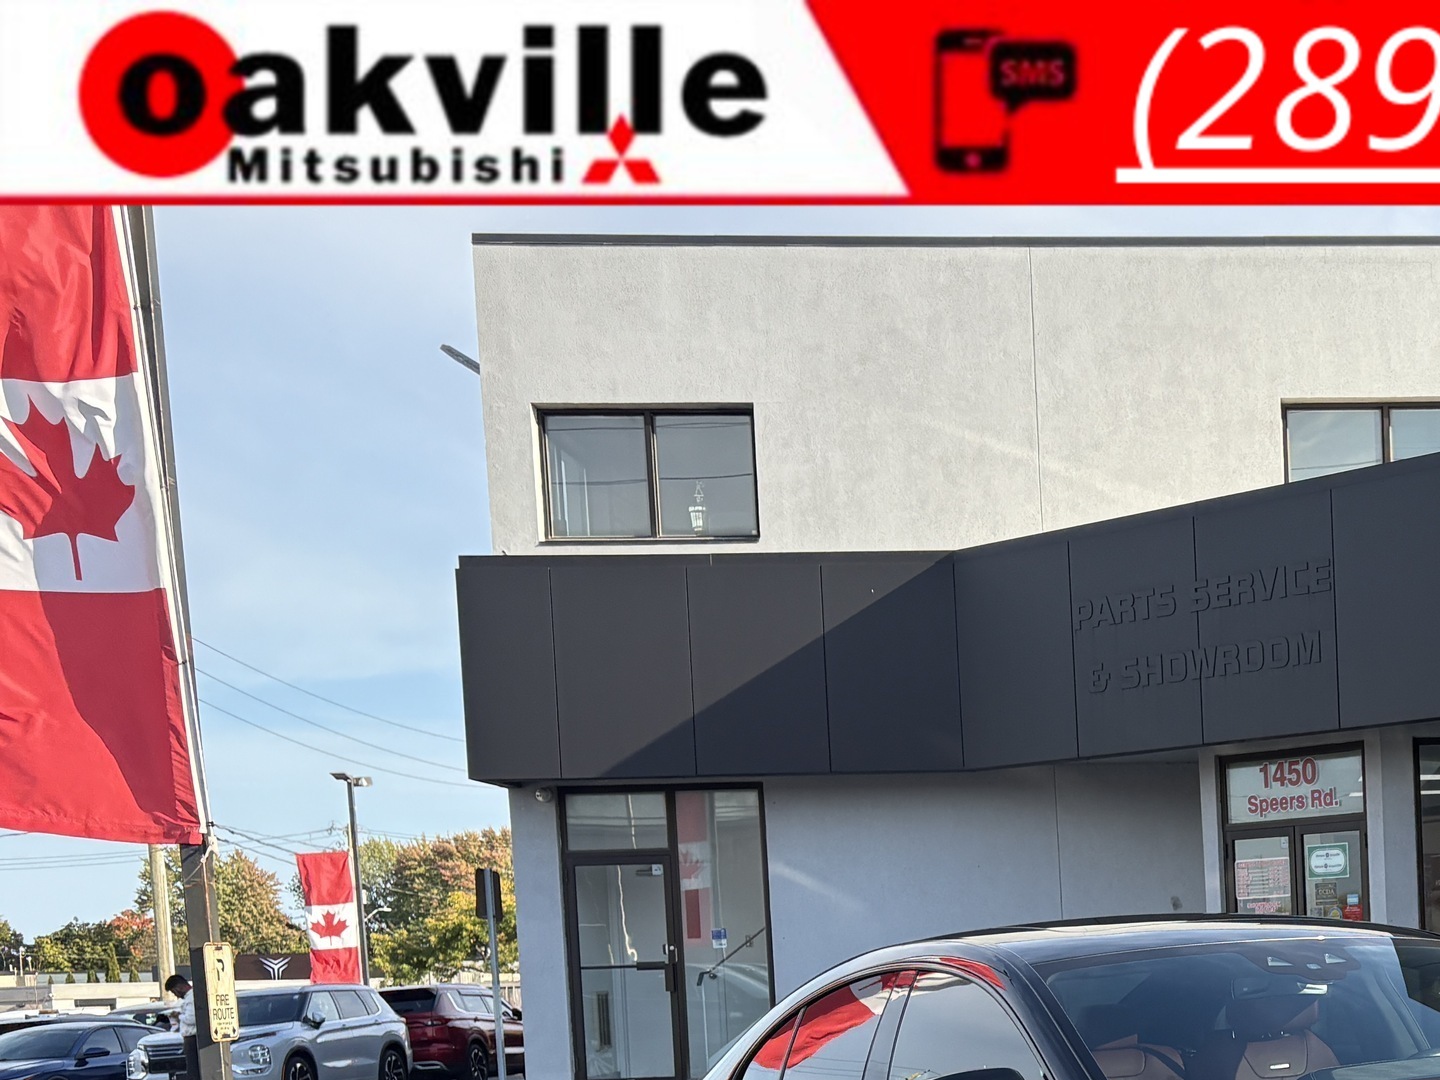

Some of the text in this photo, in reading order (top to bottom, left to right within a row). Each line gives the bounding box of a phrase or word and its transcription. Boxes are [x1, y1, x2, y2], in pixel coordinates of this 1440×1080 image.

[1074, 558, 1332, 631] PARTS SERVICE
[1121, 630, 1322, 691] SHOWROOM
[1259, 757, 1318, 789] 1450
[1247, 787, 1339, 818] Speers Rd.
[212, 1007, 235, 1021] ROUTE
[215, 993, 230, 1006] FIRE
